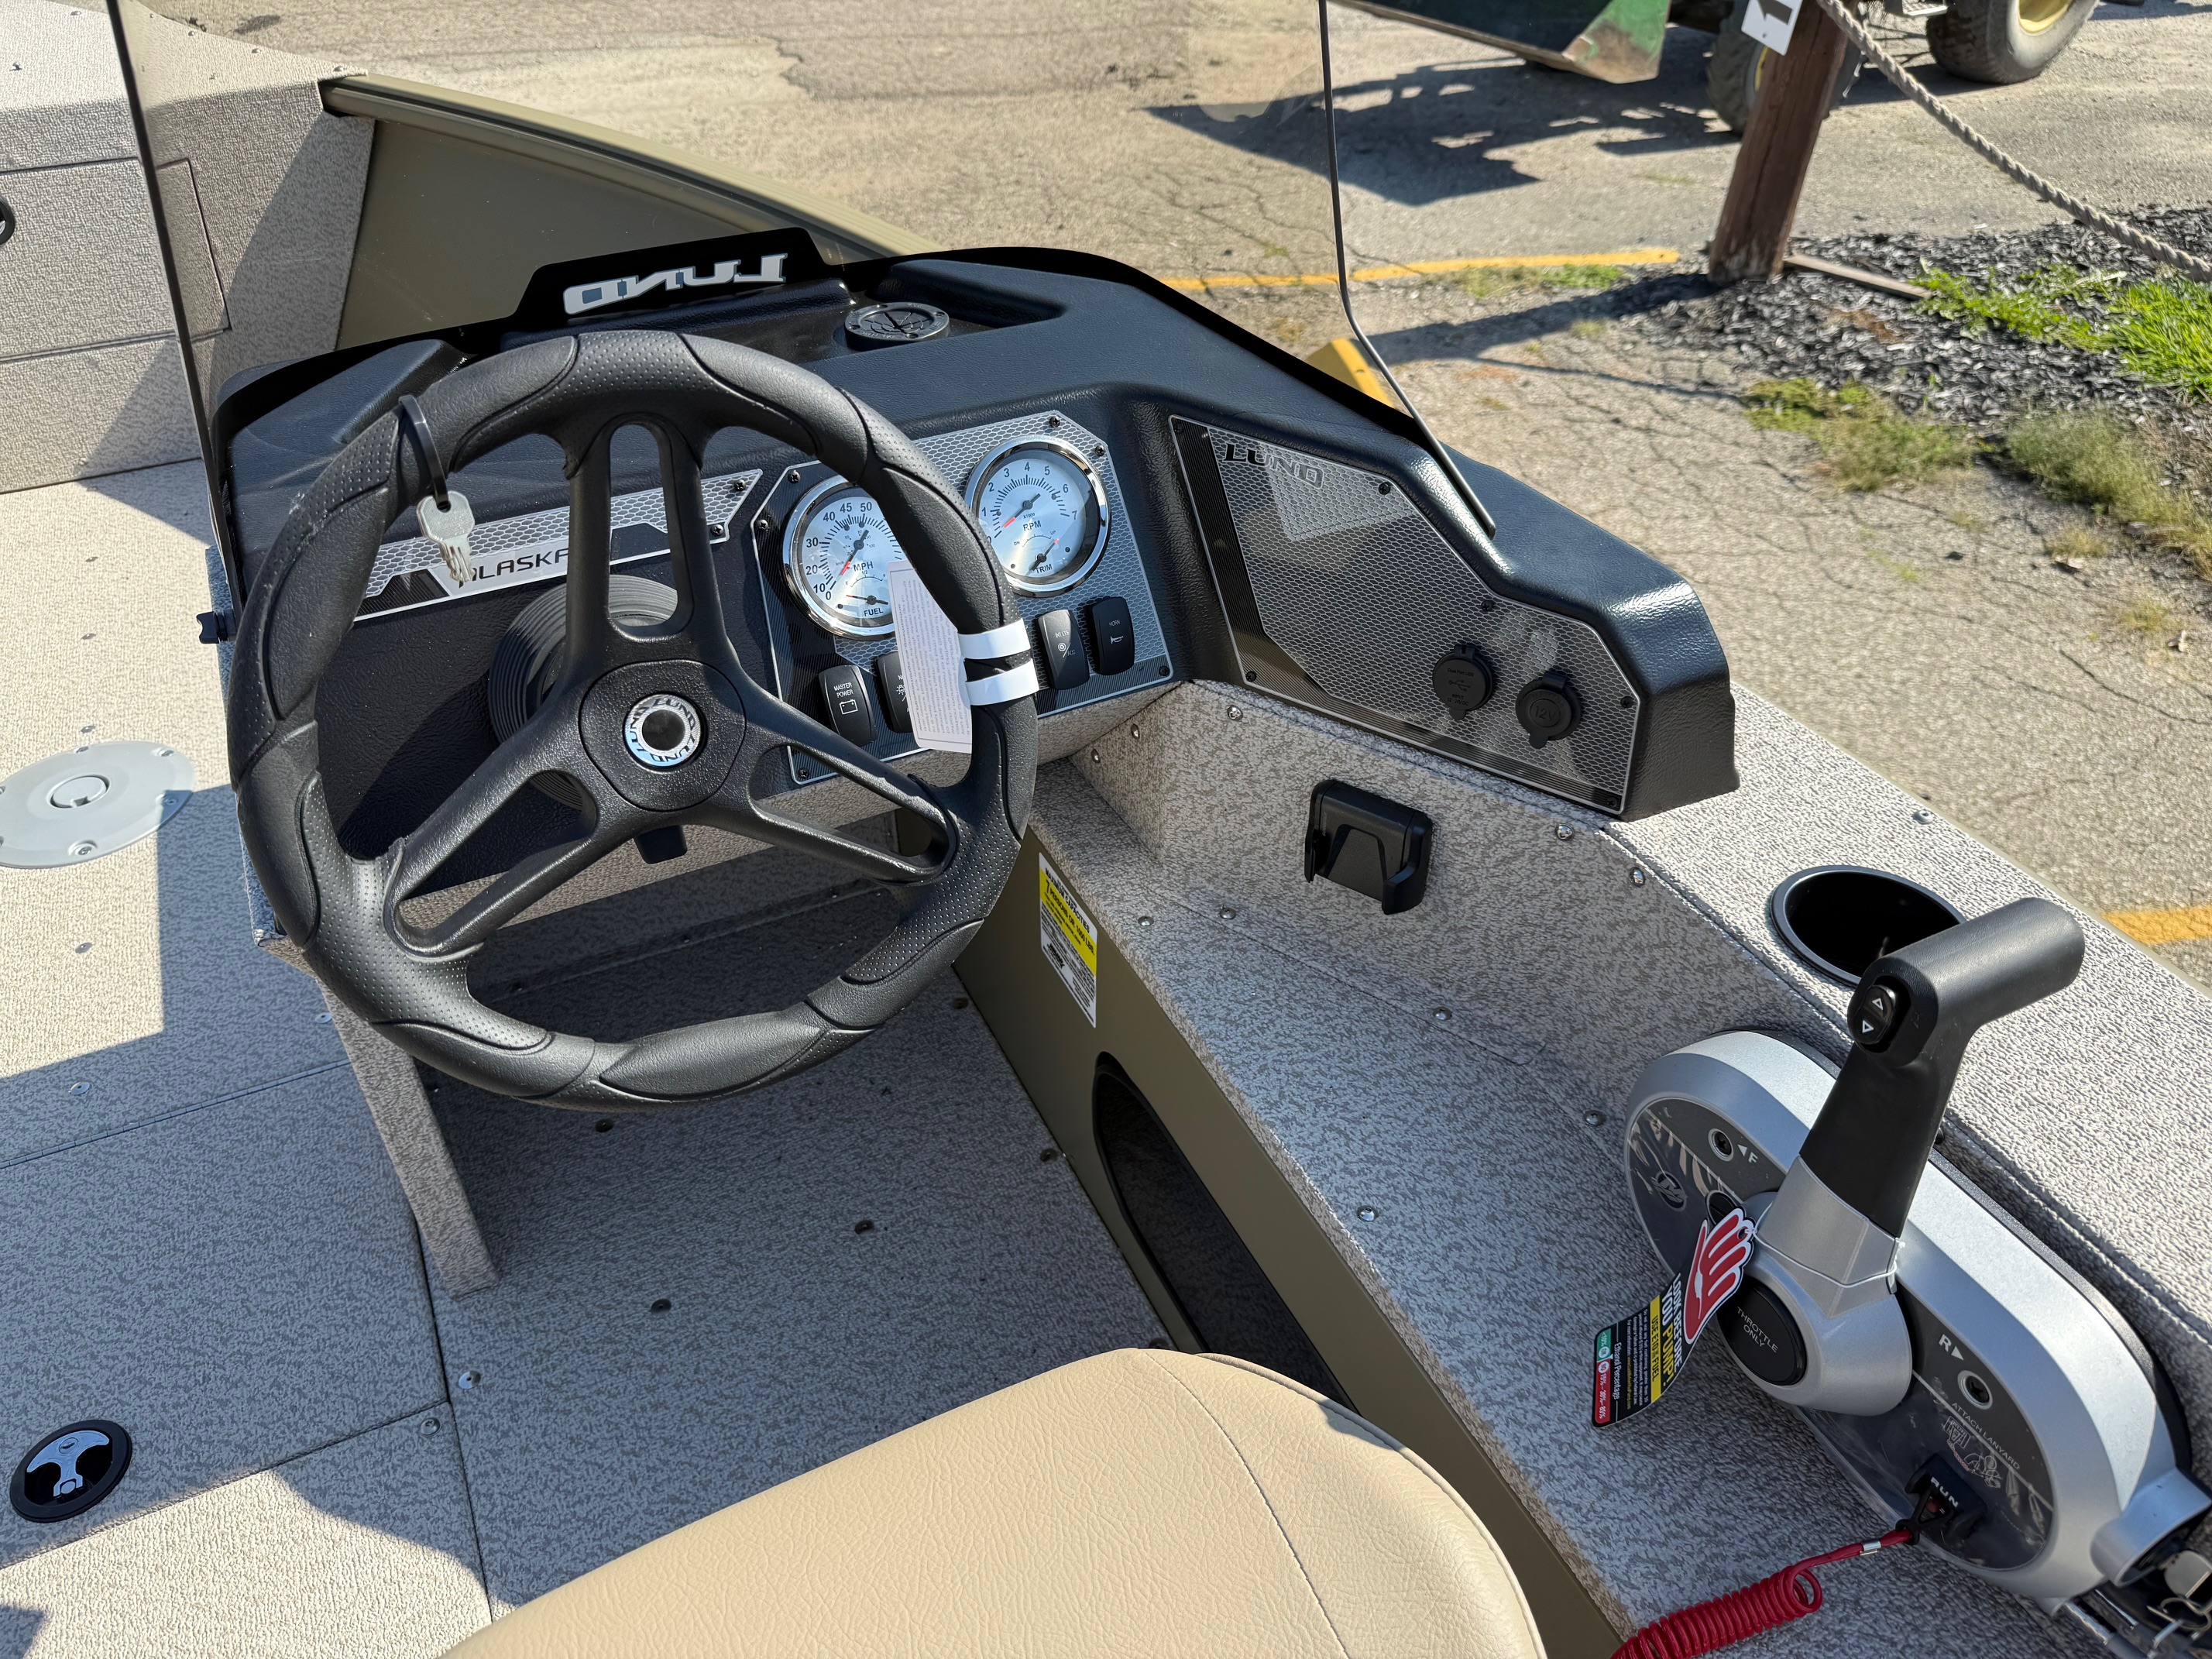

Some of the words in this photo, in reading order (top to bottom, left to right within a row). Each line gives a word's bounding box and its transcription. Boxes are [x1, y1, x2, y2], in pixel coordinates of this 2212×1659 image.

[1024, 462, 1030, 472] 4
[1044, 465, 1050, 476] 5
[1223, 441, 1324, 489] LUND
[1004, 468, 1010, 478] 3
[988, 482, 994, 492] 2
[1063, 483, 1069, 493] 6
[840, 503, 852, 513] 45
[860, 502, 872, 513] 50
[981, 507, 987, 517] 1
[823, 512, 836, 522] 40
[1071, 510, 1077, 520] 7
[1022, 520, 1042, 532] RPM
[806, 538, 819, 548] 30
[459, 548, 568, 588] LASKA
[805, 565, 818, 575] 20
[854, 562, 874, 572] MPH
[1036, 564, 1053, 574] TRIM
[813, 583, 826, 593] 10
[826, 591, 831, 600] 0
[864, 607, 884, 617] FUEL
[833, 682, 853, 691] MASTER
[836, 689, 854, 698] POWER
[1536, 706, 1556, 721] 12V
[1748, 1152, 1758, 1163] F
[1672, 1273, 1681, 1314] LOOK
[1661, 1285, 1673, 1327] YOU
[1737, 1306, 1778, 1353] THROTTLE
[1743, 1324, 1765, 1347] ONLY
[1673, 1310, 1682, 1373] BEFORE
[1939, 1334, 1952, 1352] R
[1613, 1341, 1622, 1364] Ethanol
[1662, 1322, 1674, 1386] PUMP!
[1612, 1365, 1622, 1400] Percentage
[1951, 1402, 1983, 1432] ATTACH
[1983, 1431, 2020, 1470] LANYARD
[1930, 1476, 1959, 1508] RUN
